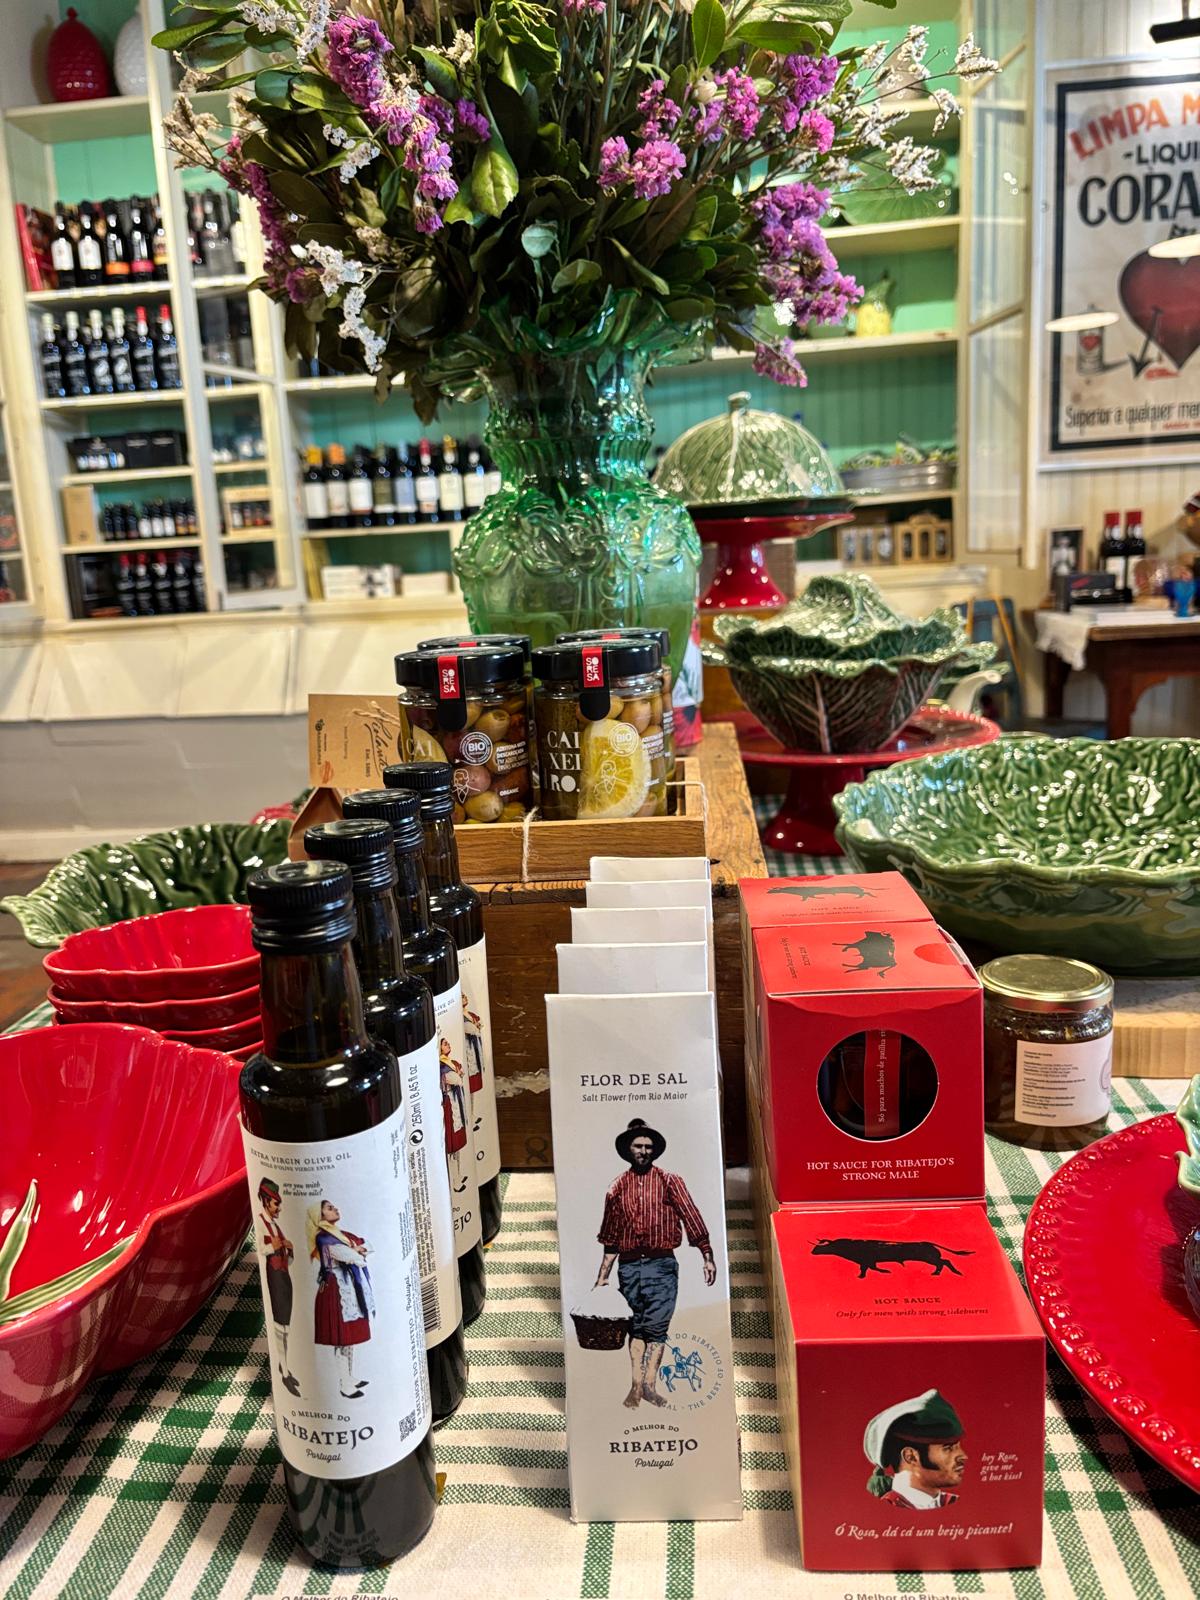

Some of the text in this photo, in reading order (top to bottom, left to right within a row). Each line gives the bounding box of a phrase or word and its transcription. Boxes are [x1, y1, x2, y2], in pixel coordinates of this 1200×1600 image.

[1069, 98, 1171, 161] LIMPA
[1078, 170, 1200, 227] CORA
[1065, 404, 1112, 436] Superior
[468, 742, 486, 751] BIO
[547, 731, 581, 749] CAI
[549, 753, 583, 771] XEI
[876, 1060, 885, 1069] de
[580, 1072, 688, 1087] FLOR DE SAL
[876, 1070, 885, 1096] machos
[582, 1091, 688, 1102] Salt Flower from Rio Maior
[879, 1097, 887, 1113] para
[878, 1113, 885, 1123] Só
[250, 1147, 352, 1165] EXTRA VIRGIN OLIVE OIL
[807, 1157, 955, 1170] HOT SAUCE FOR RIBATEJO'S
[842, 1170, 920, 1181] STRONG MALE
[305, 1180, 321, 1188] with
[836, 1310, 858, 1319] Only
[858, 1310, 872, 1319] for
[895, 1309, 917, 1317] with
[919, 1309, 946, 1318] strong
[947, 1307, 989, 1315] sideburns
[691, 1335, 723, 1365] RIBATEJO
[688, 1368, 724, 1411] THE BEST OF
[298, 1410, 334, 1420] MELHOR
[337, 1414, 351, 1422] DO
[282, 1416, 374, 1450] RIBATEJO
[632, 1424, 665, 1432] MELHOR
[609, 1438, 698, 1457] RIBATEJO
[306, 1448, 342, 1463] Portugal
[634, 1457, 674, 1470] Portugal
[989, 1472, 1002, 1481] hot
[835, 1522, 1013, 1540] Ó Rosa, dá cá um beijo picante!
